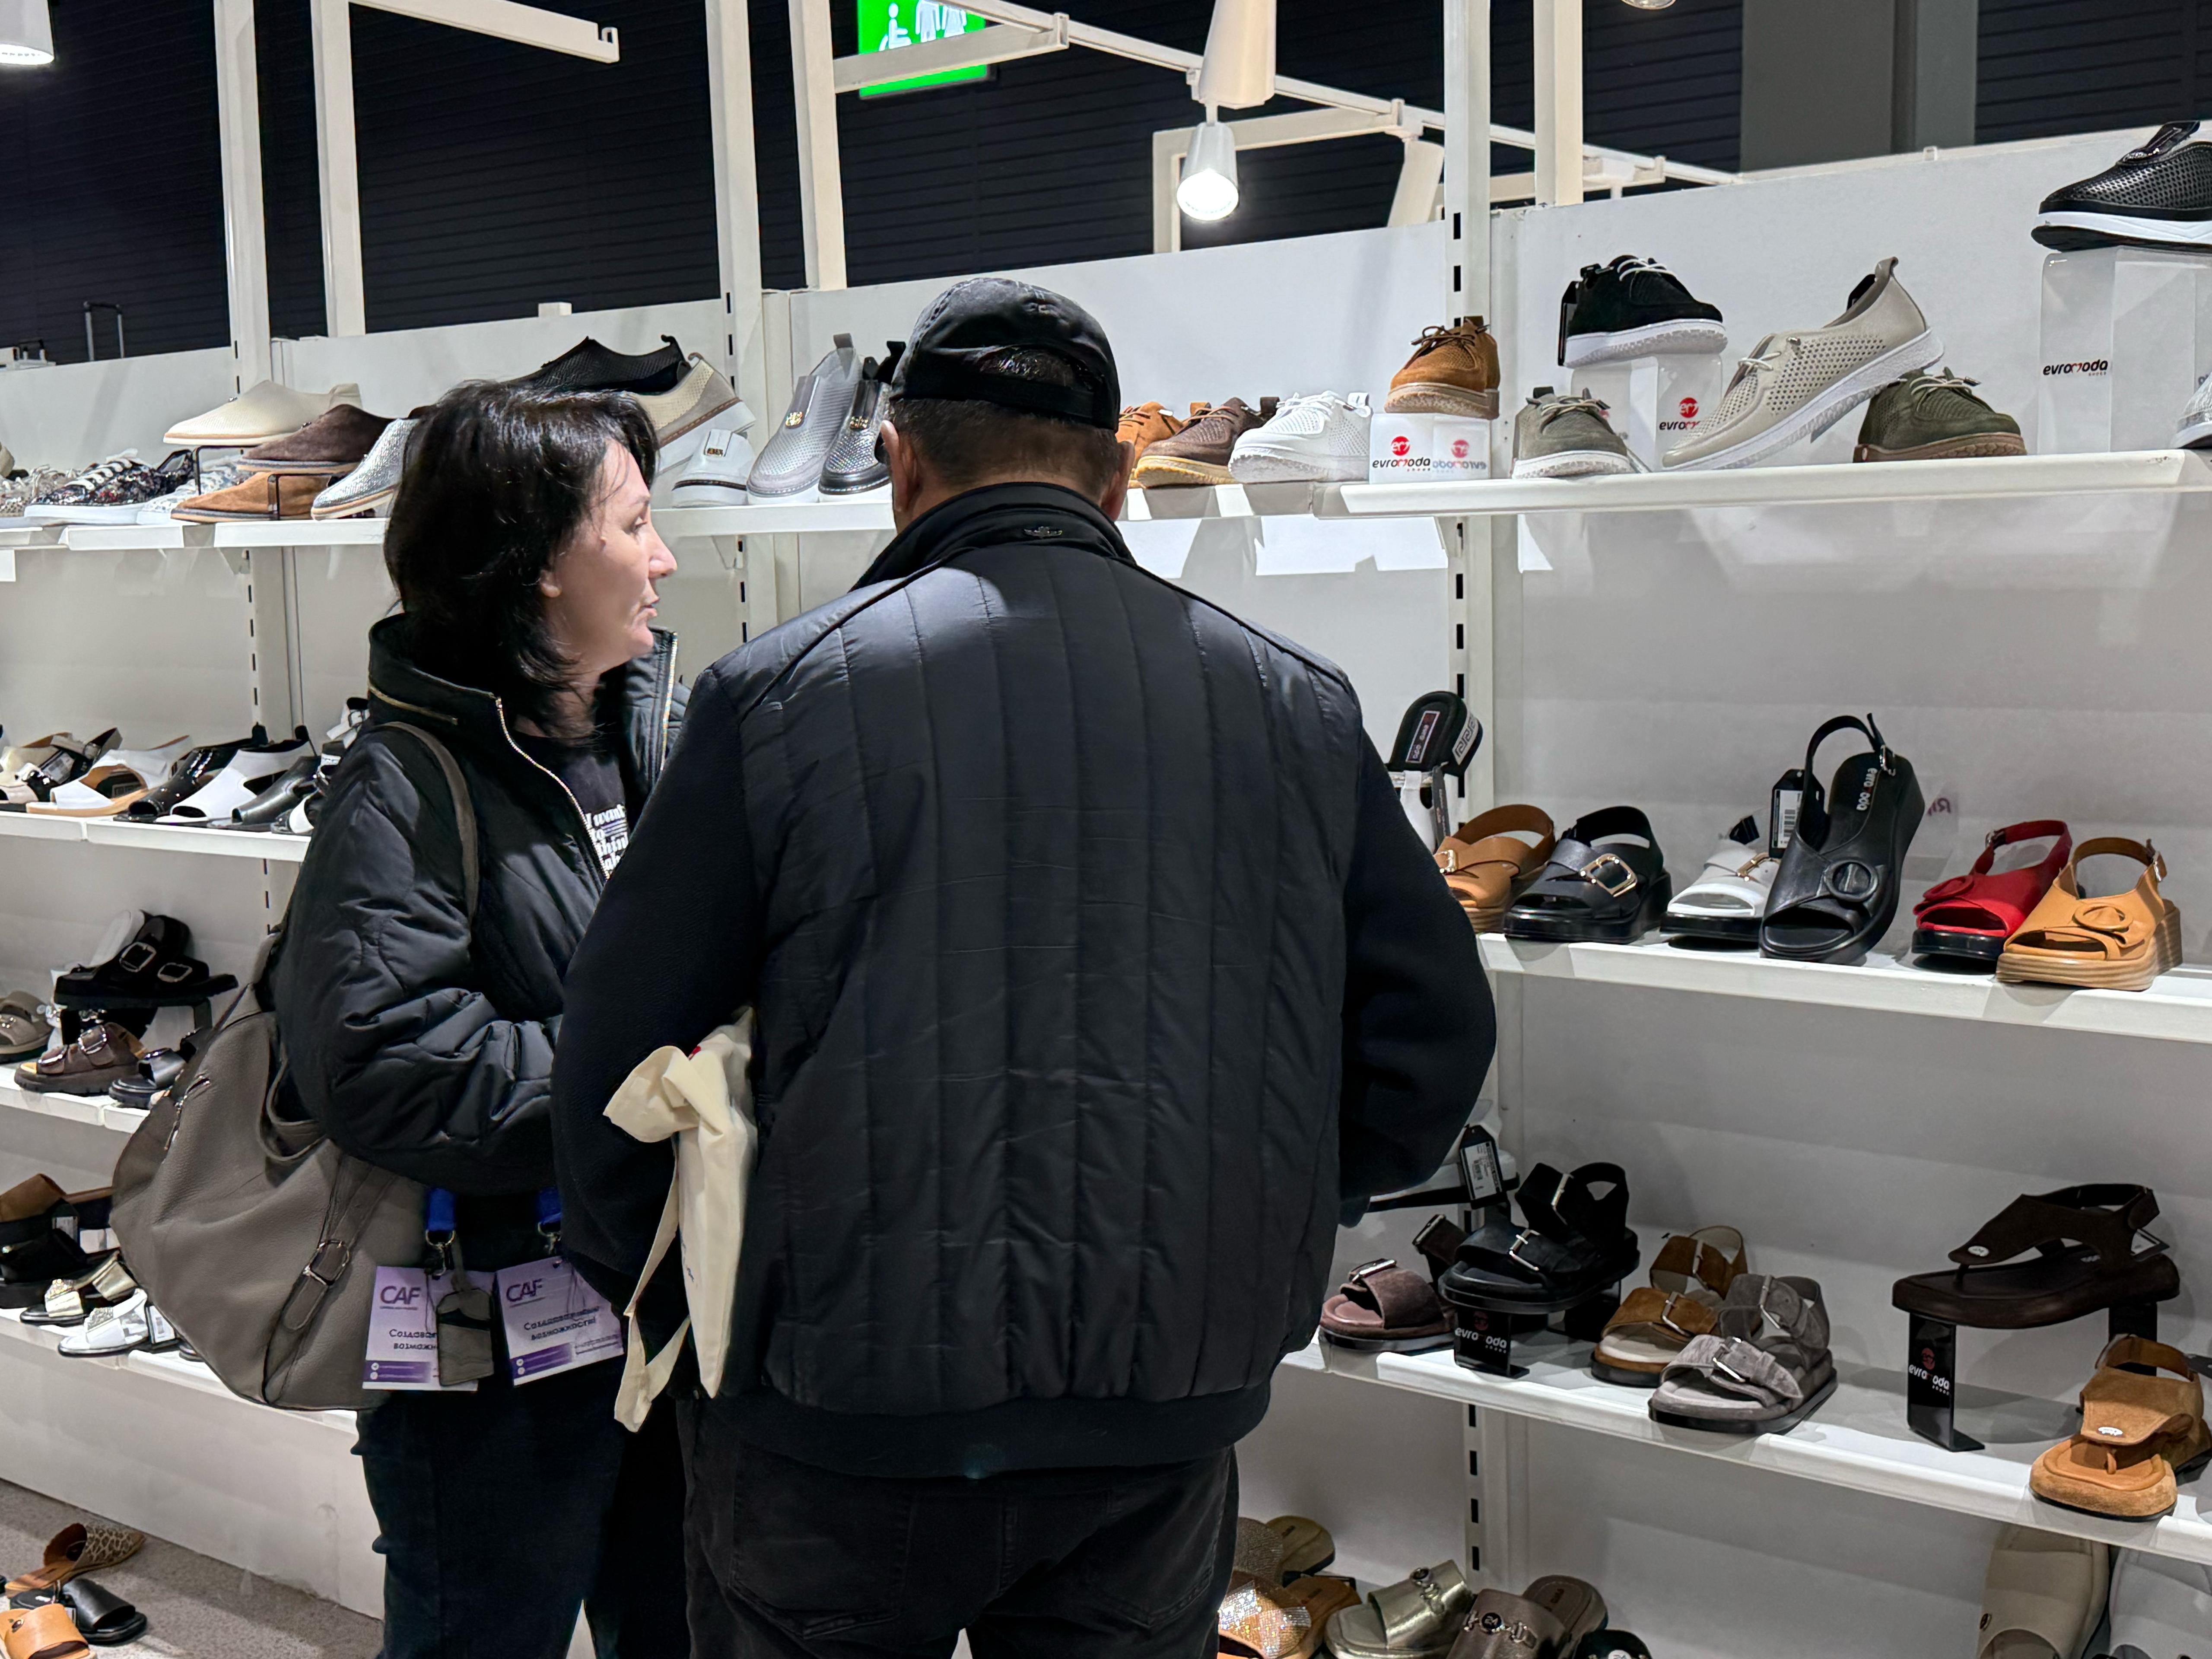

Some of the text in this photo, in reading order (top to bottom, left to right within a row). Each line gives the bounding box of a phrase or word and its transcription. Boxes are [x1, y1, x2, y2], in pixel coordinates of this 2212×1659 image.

[2043, 359, 2108, 375] evromoda
[1659, 420, 1700, 431] evrom
[1372, 457, 1431, 468] evromoda
[380, 1285, 422, 1305] CAF
[506, 1278, 543, 1303] CAF
[1455, 1327, 1507, 1348] evrooda
